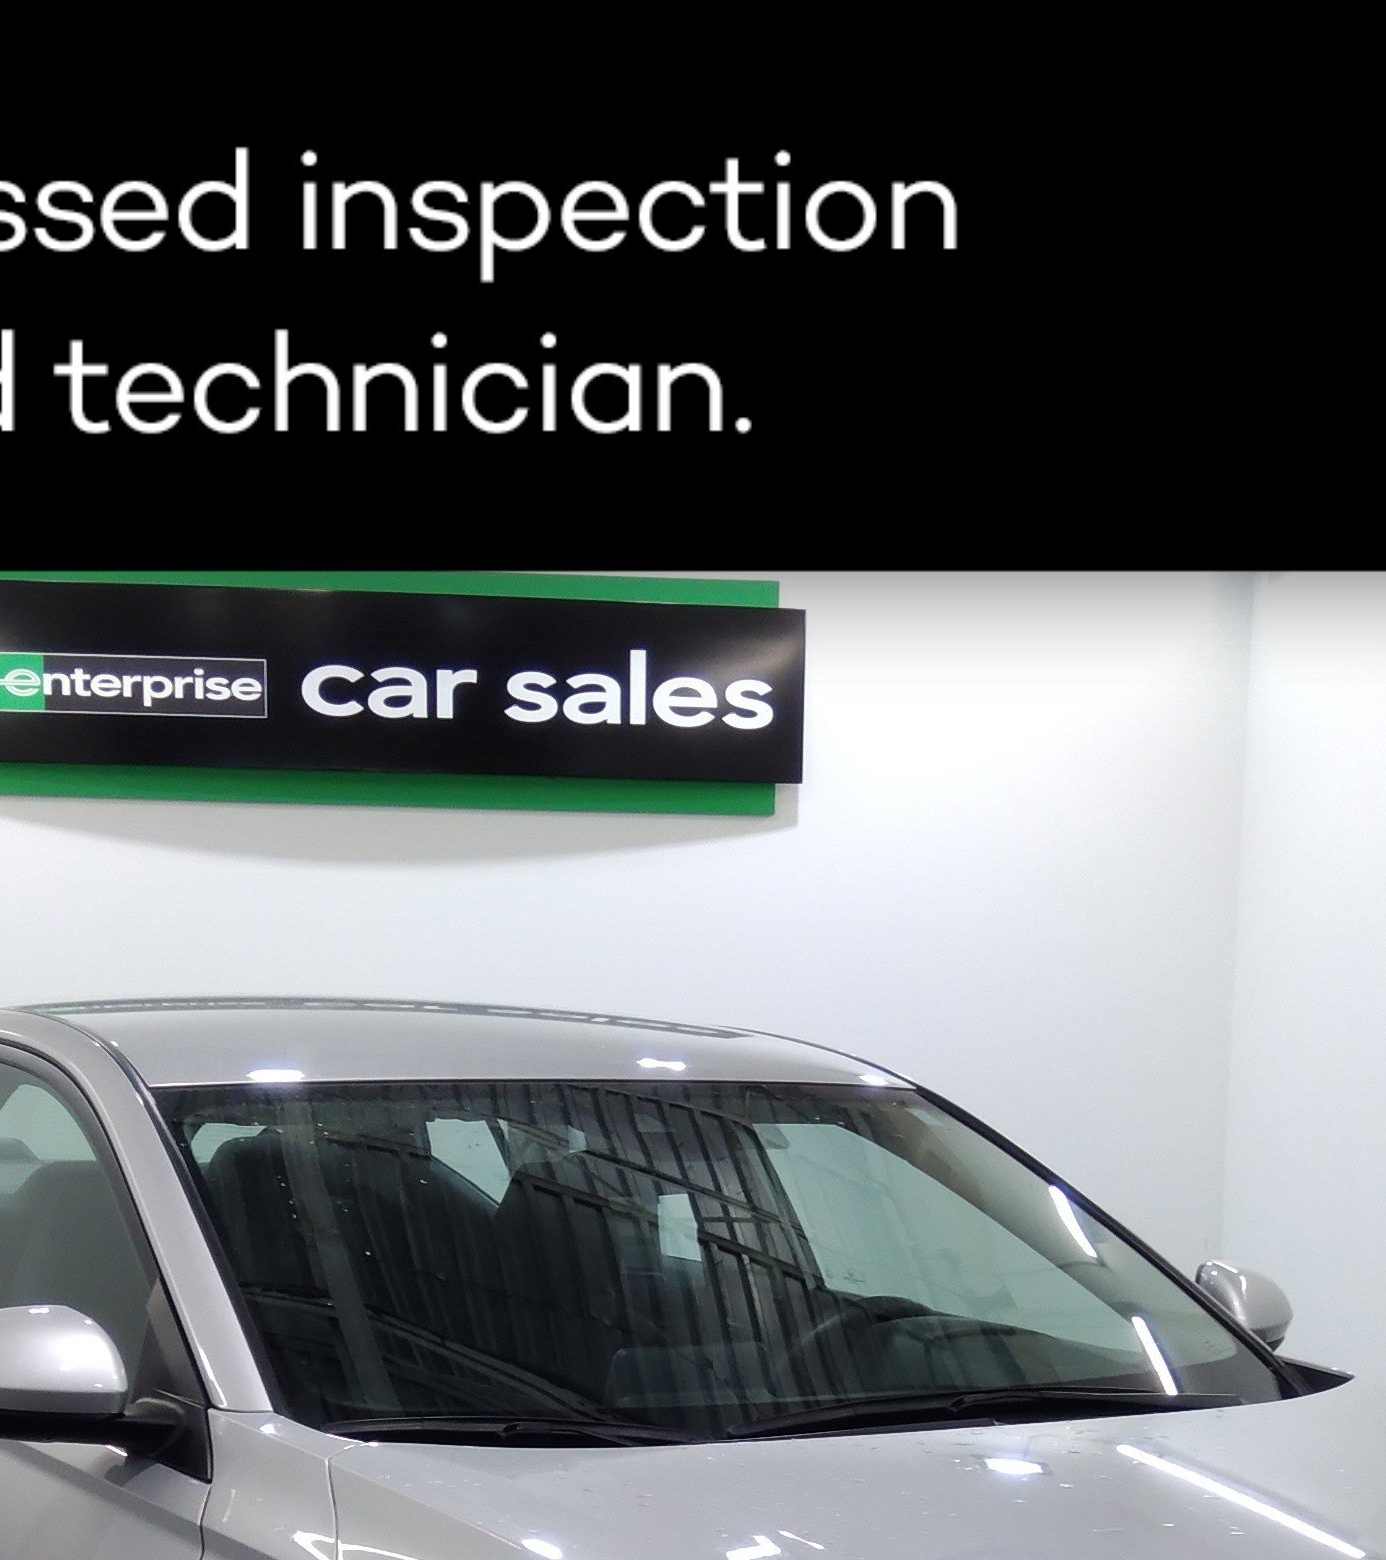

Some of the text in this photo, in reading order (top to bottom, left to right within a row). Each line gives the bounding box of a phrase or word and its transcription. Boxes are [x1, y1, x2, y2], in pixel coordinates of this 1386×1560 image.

[3, 648, 775, 730] enterprise car sales
